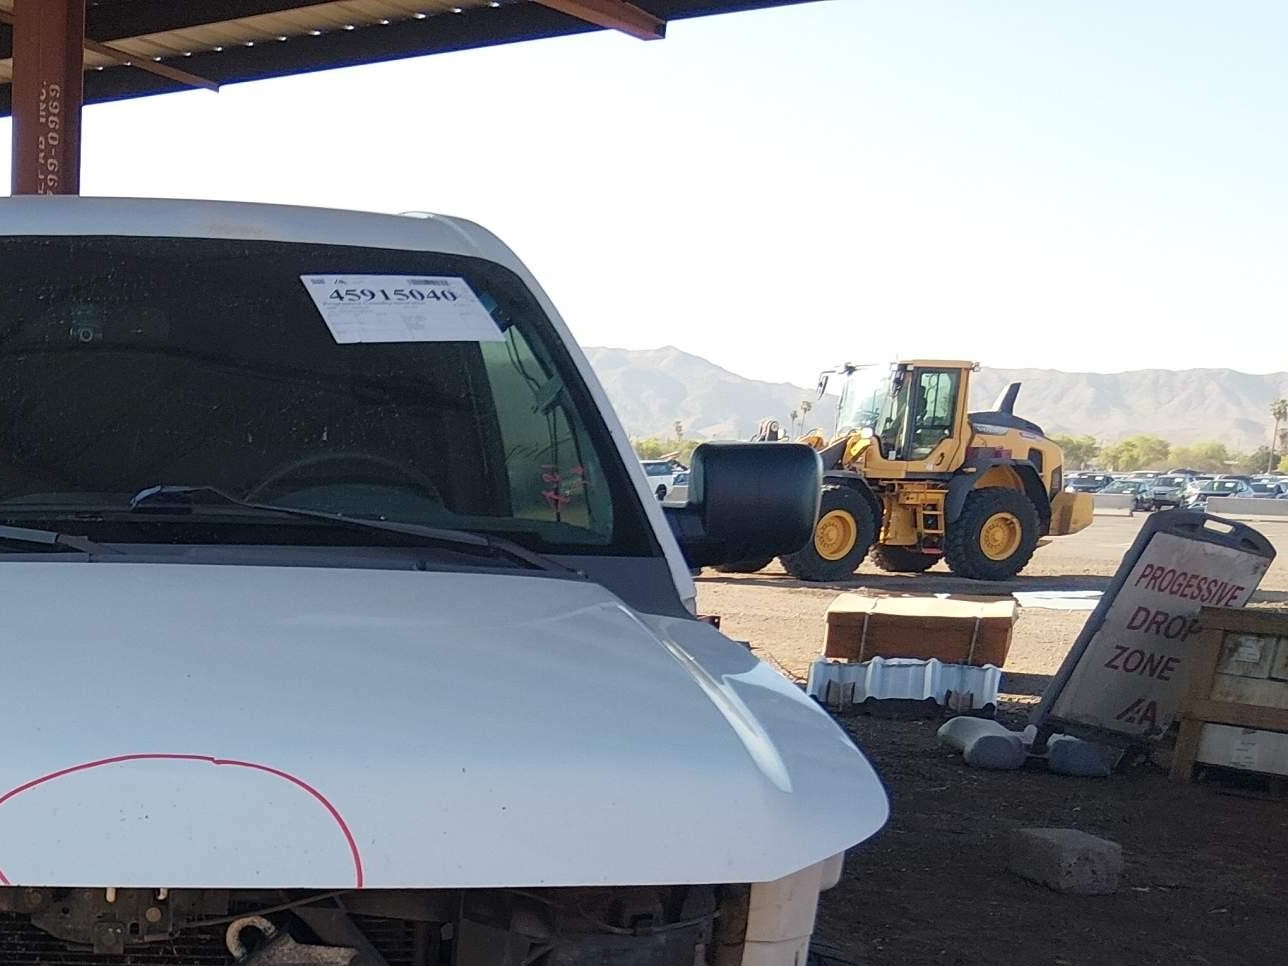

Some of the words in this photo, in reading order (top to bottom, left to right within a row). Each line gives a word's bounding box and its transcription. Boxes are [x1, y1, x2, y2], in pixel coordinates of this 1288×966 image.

[329, 288, 457, 302] 45915040
[1134, 563, 1245, 607] PROGESSIVE
[1127, 606, 1203, 642] DROP
[1104, 645, 1181, 681] ZONE
